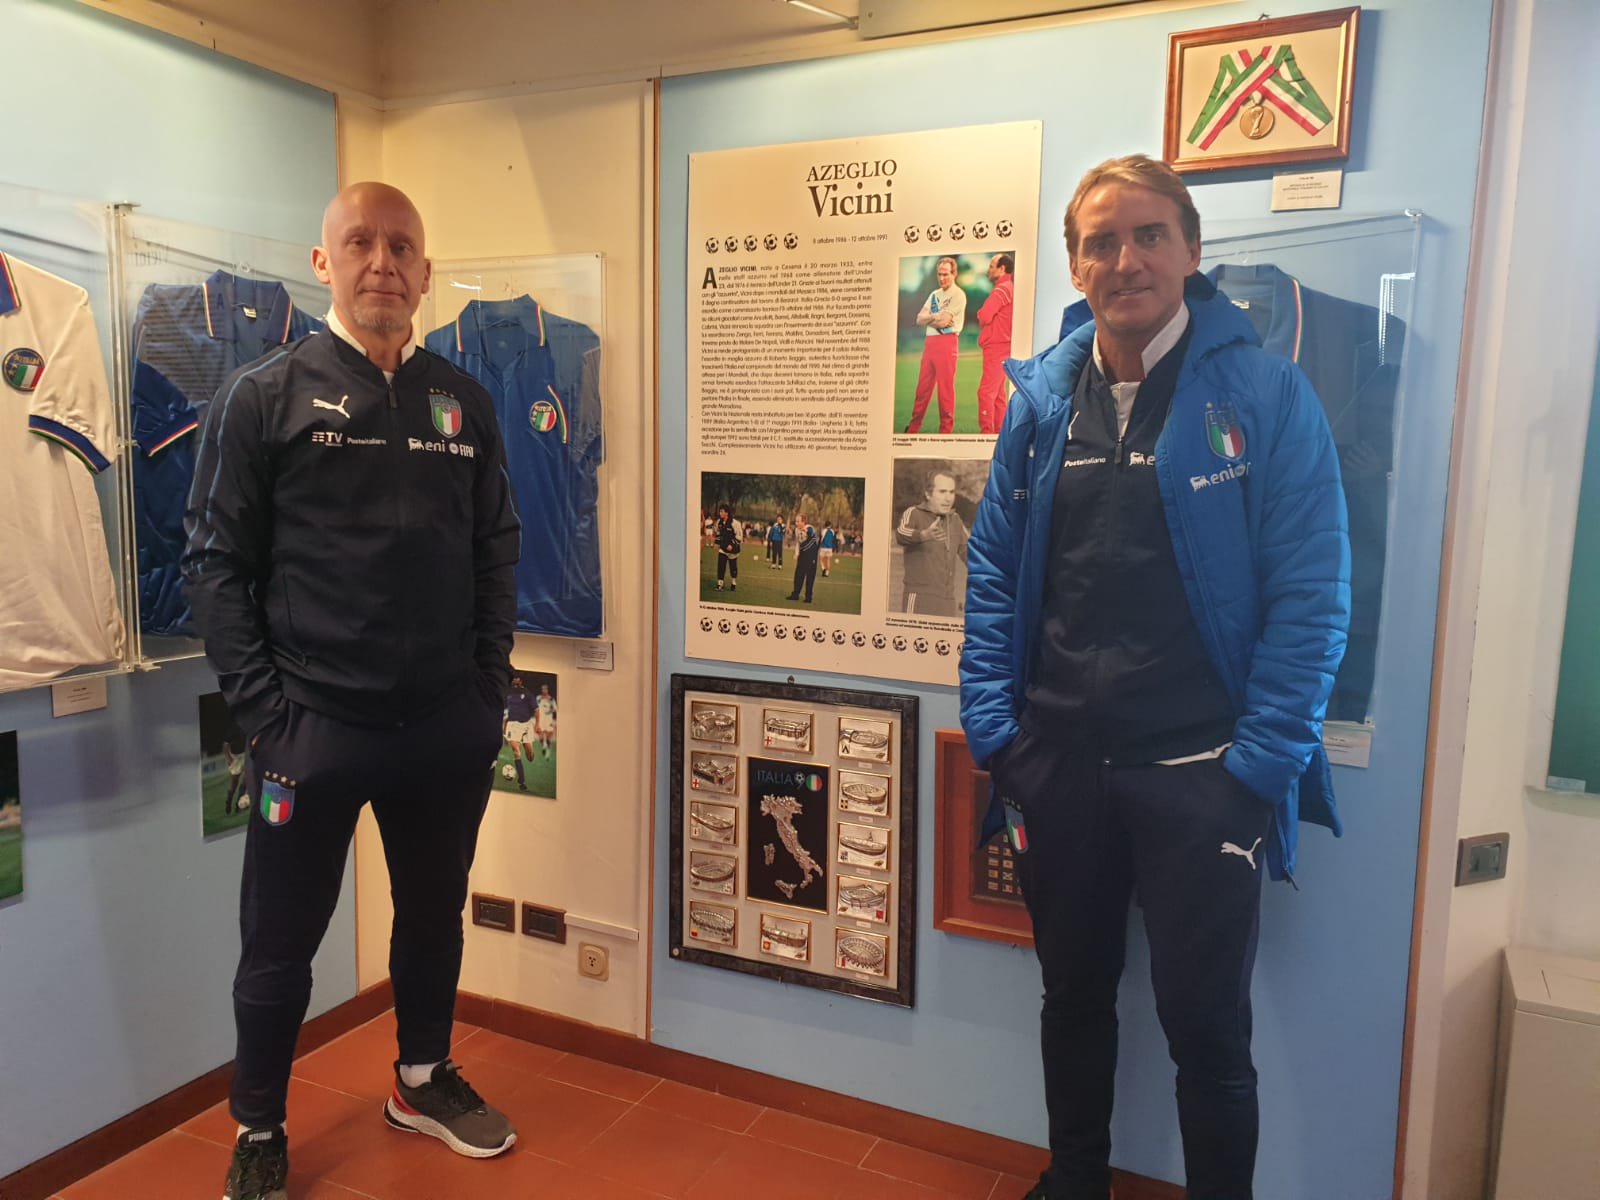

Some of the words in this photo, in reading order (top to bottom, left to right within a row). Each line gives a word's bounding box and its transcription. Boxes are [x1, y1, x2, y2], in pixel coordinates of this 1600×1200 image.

[806, 159, 897, 182] AZEGLIO
[807, 179, 894, 218] Vicini
[702, 267, 718, 289] A
[325, 431, 343, 443] TV
[425, 439, 446, 452] eni
[1210, 463, 1236, 485] eni
[756, 769, 794, 785] ITALIA
